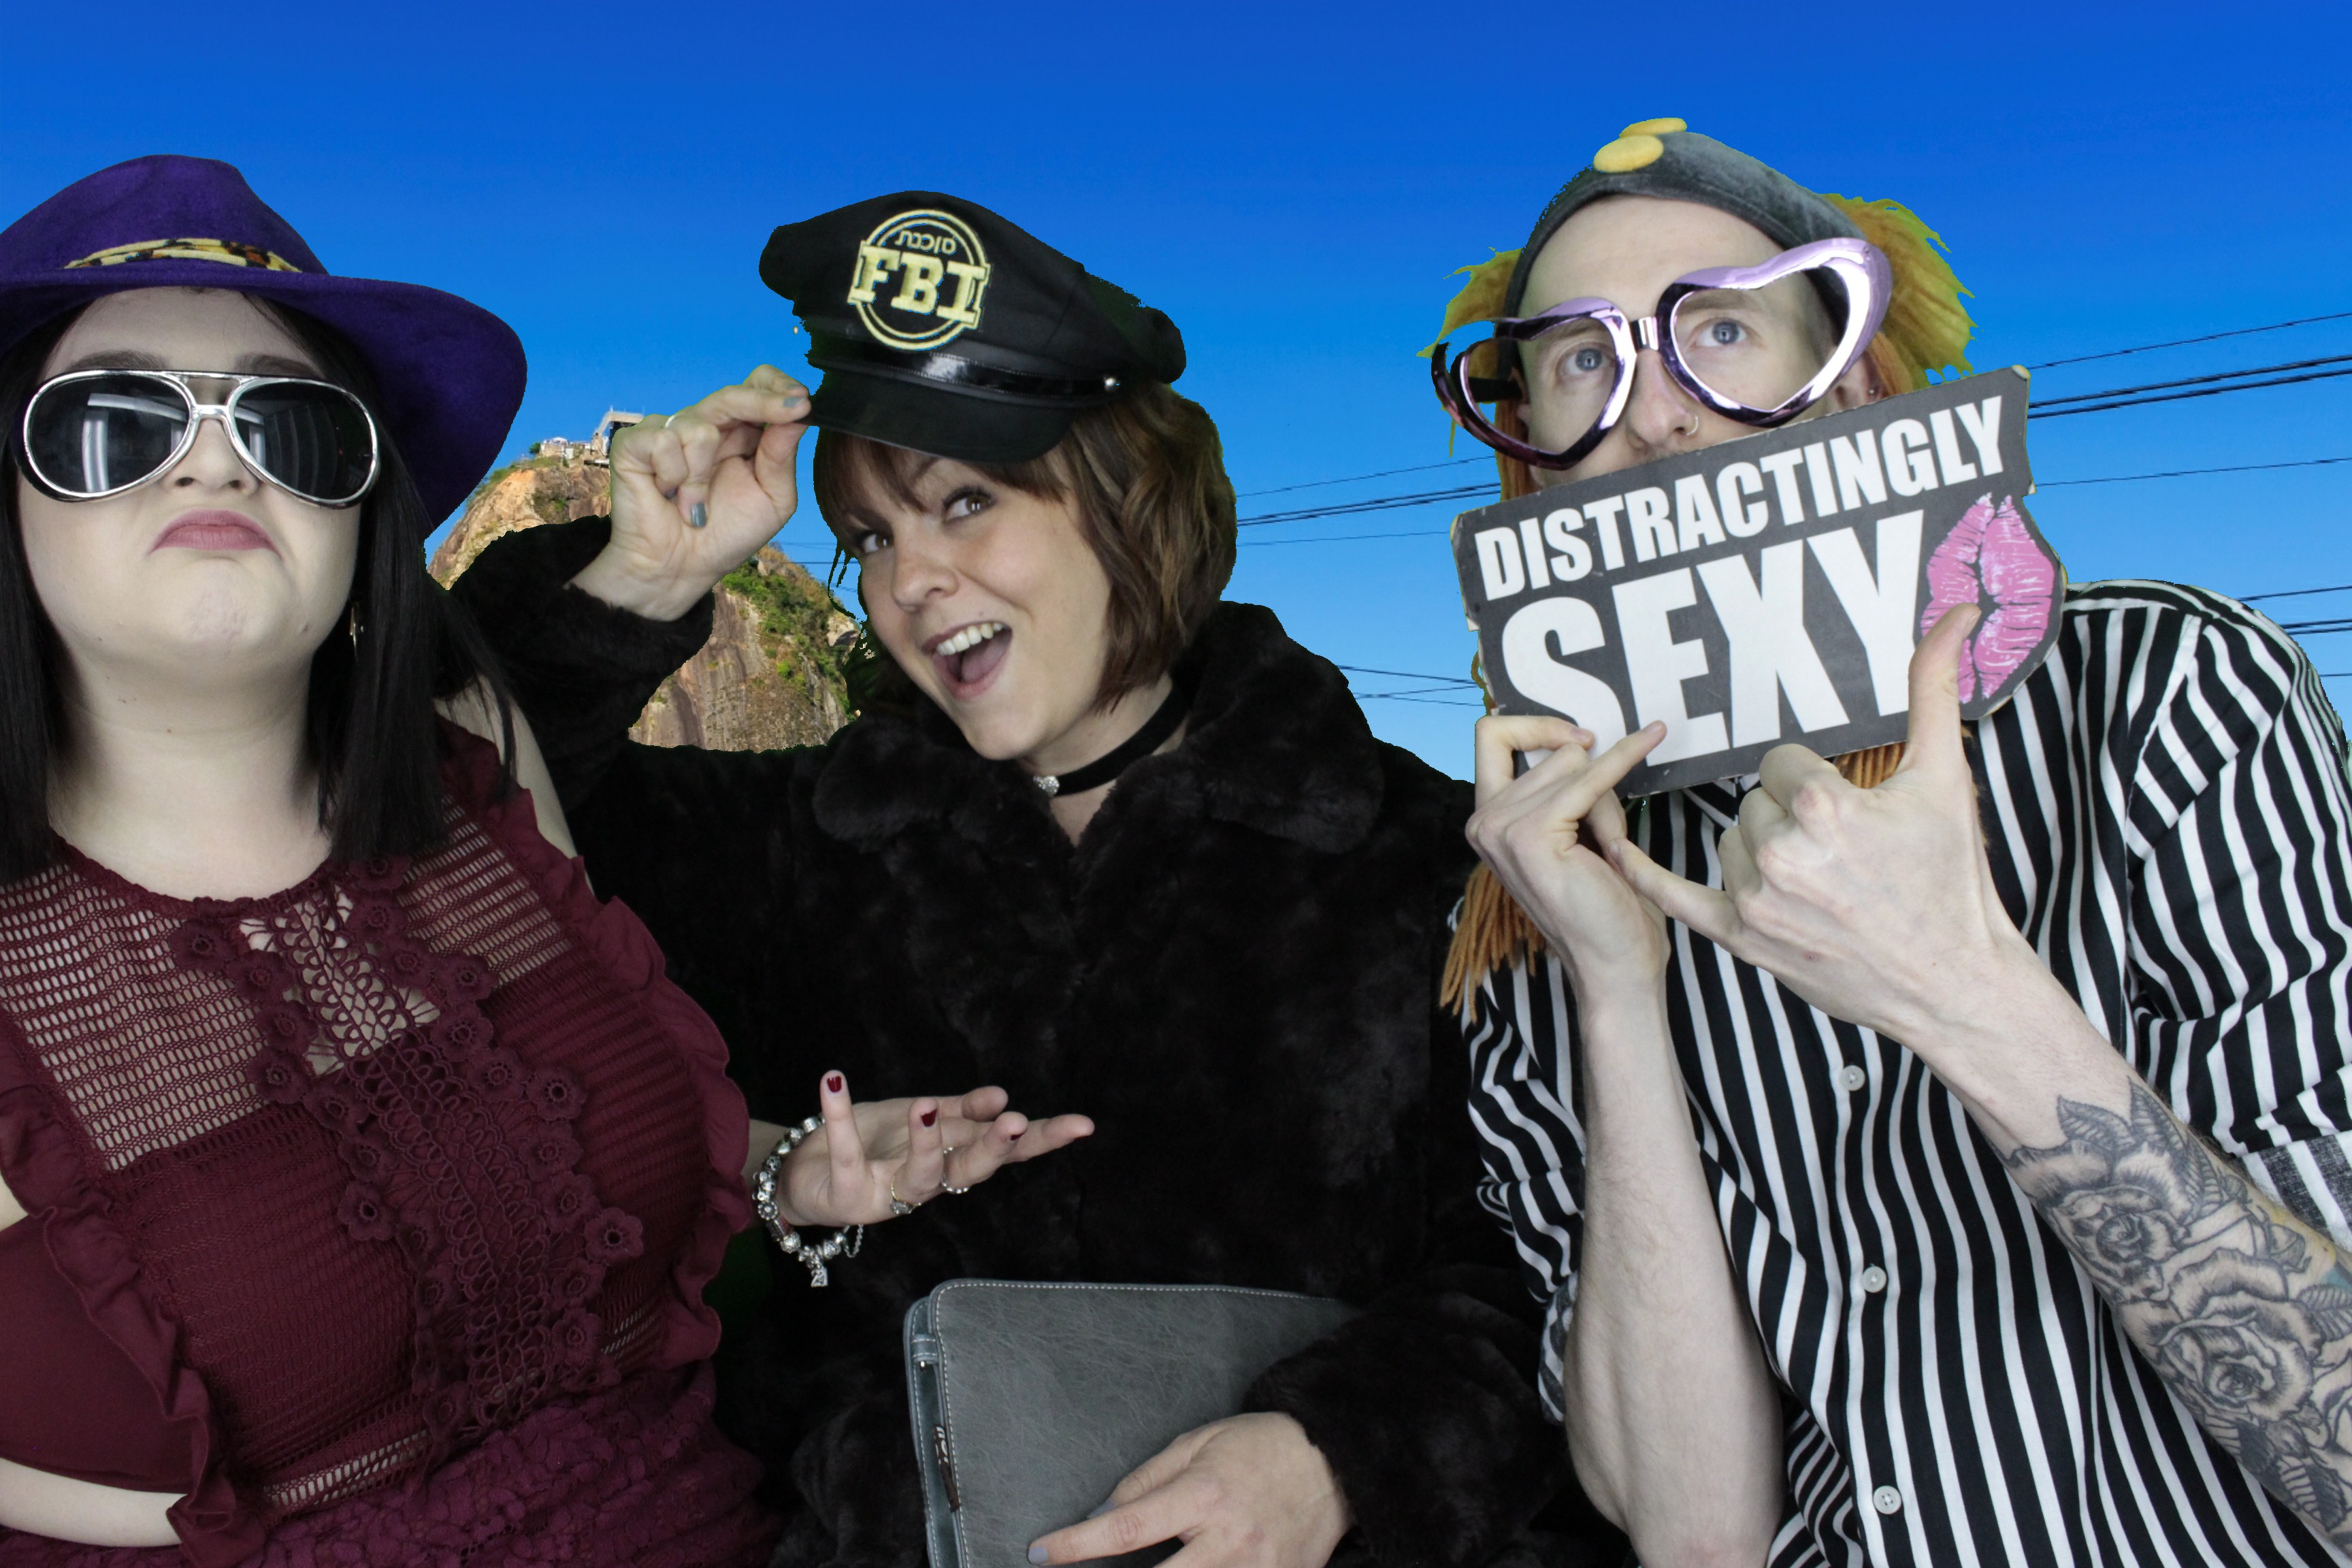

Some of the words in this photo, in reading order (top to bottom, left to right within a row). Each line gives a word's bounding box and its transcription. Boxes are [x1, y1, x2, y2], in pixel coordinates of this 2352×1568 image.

[849, 244, 987, 325] FBI
[1474, 395, 2004, 601] DISTRACTINGLY
[1502, 510, 1924, 768] SEXY
